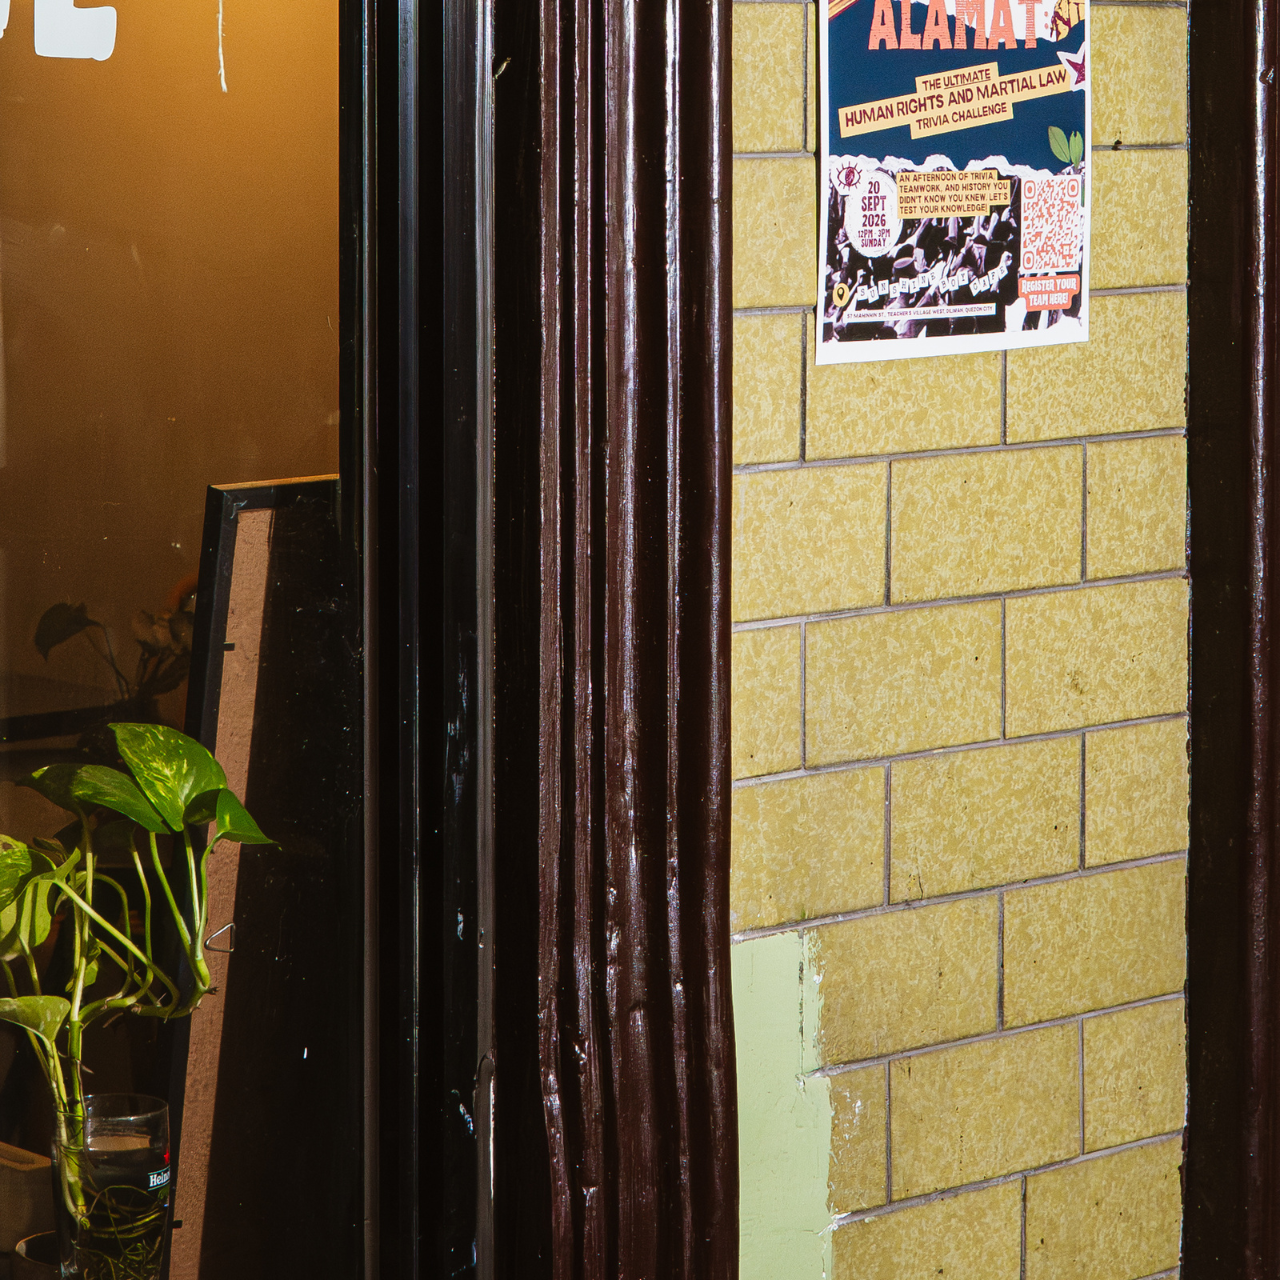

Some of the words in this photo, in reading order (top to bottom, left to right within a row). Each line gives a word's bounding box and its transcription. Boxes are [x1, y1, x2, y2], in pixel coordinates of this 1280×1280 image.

[922, 78, 942, 91] THE
[943, 68, 991, 88] ULTIMATE
[845, 103, 894, 128] HUMAN
[896, 94, 944, 116] RIGHTS
[948, 88, 974, 106] AND
[976, 76, 1036, 100] MARTIAL
[1039, 69, 1067, 88] LAW
[916, 114, 950, 130] TRIVIA
[952, 102, 1008, 123] CHALLENGE
[899, 174, 910, 182] AN
[913, 172, 956, 182] AFTERNOON
[958, 172, 968, 180] OF
[868, 180, 880, 194] 20
[900, 184, 942, 194] TEAMWORK,
[945, 184, 960, 192] AND
[962, 183, 991, 192] HISTORY
[993, 182, 1008, 190] YOU
[861, 195, 887, 212] SEPT
[900, 196, 922, 204] DIDN'T
[924, 194, 946, 204] KNOW
[948, 194, 962, 202] YOU
[965, 194, 988, 202] KNEW.
[989, 192, 1008, 201] LET'S
[900, 206, 918, 214] TEST
[920, 205, 939, 214] YOUR
[940, 204, 988, 213] KNOWLEDGE!
[862, 214, 886, 228] 2026
[858, 229, 873, 238] 12PM
[878, 228, 890, 238] 3PM
[861, 238, 886, 248] SUNDAY
[860, 271, 936, 299] SUNSHINE
[941, 272, 966, 290] BOY
[973, 266, 1006, 290] CAFE
[1022, 279, 1055, 294] REGISTER
[1056, 278, 1076, 290] YOUR
[1028, 294, 1048, 306] TEAM
[1049, 292, 1069, 305] HERE!
